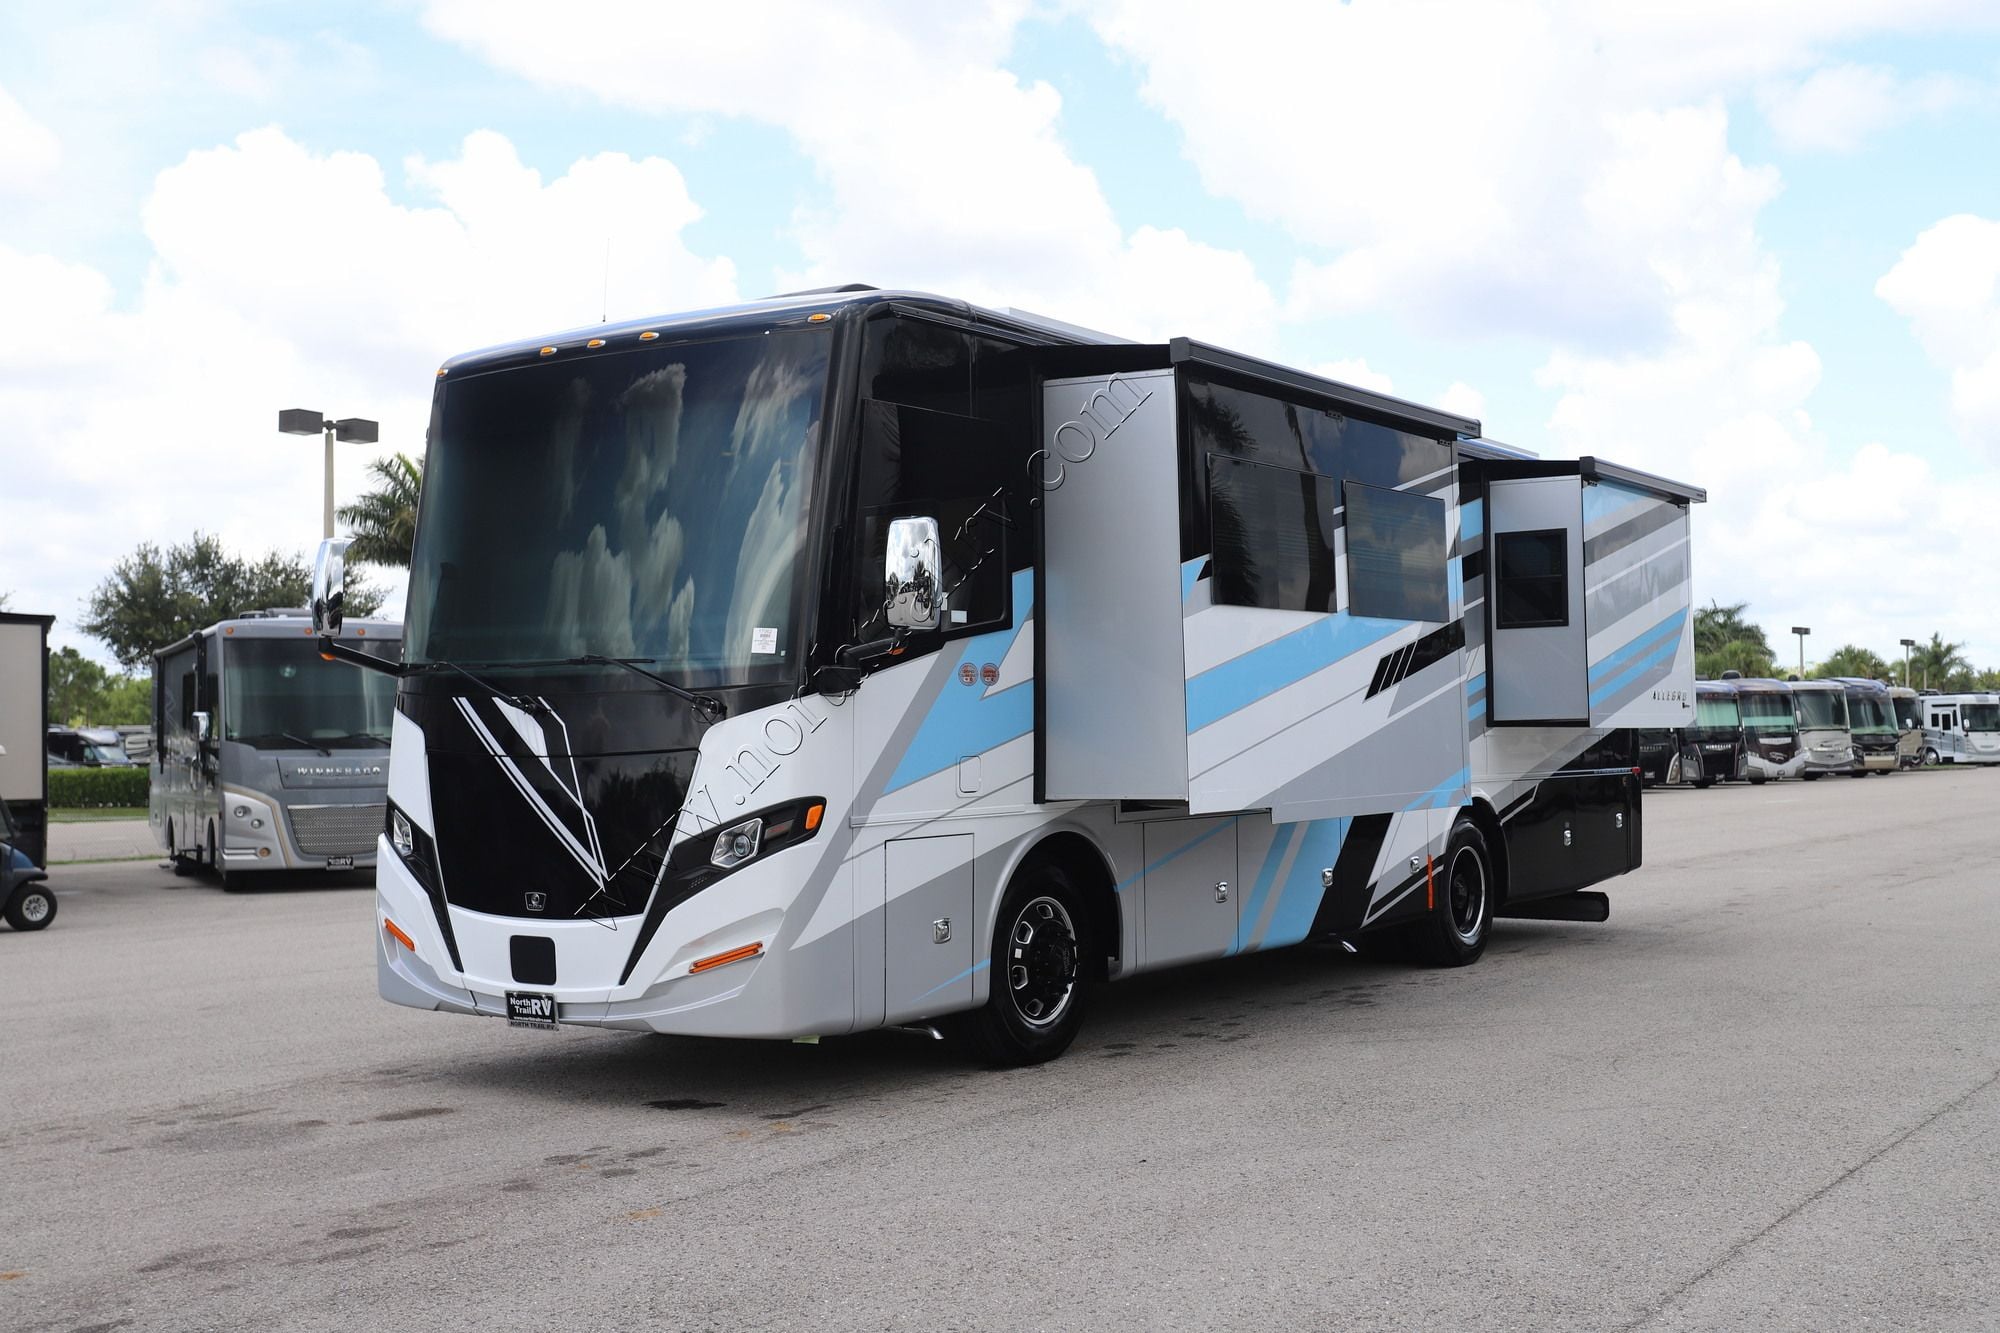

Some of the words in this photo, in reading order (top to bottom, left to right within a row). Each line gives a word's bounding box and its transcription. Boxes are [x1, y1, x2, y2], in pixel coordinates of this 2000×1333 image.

[1652, 690, 1687, 701] ALLEGRO
[510, 997, 531, 1006] North
[531, 999, 552, 1016] RV
[515, 1005, 531, 1015] Trail
[510, 1021, 529, 1029] NORTH
